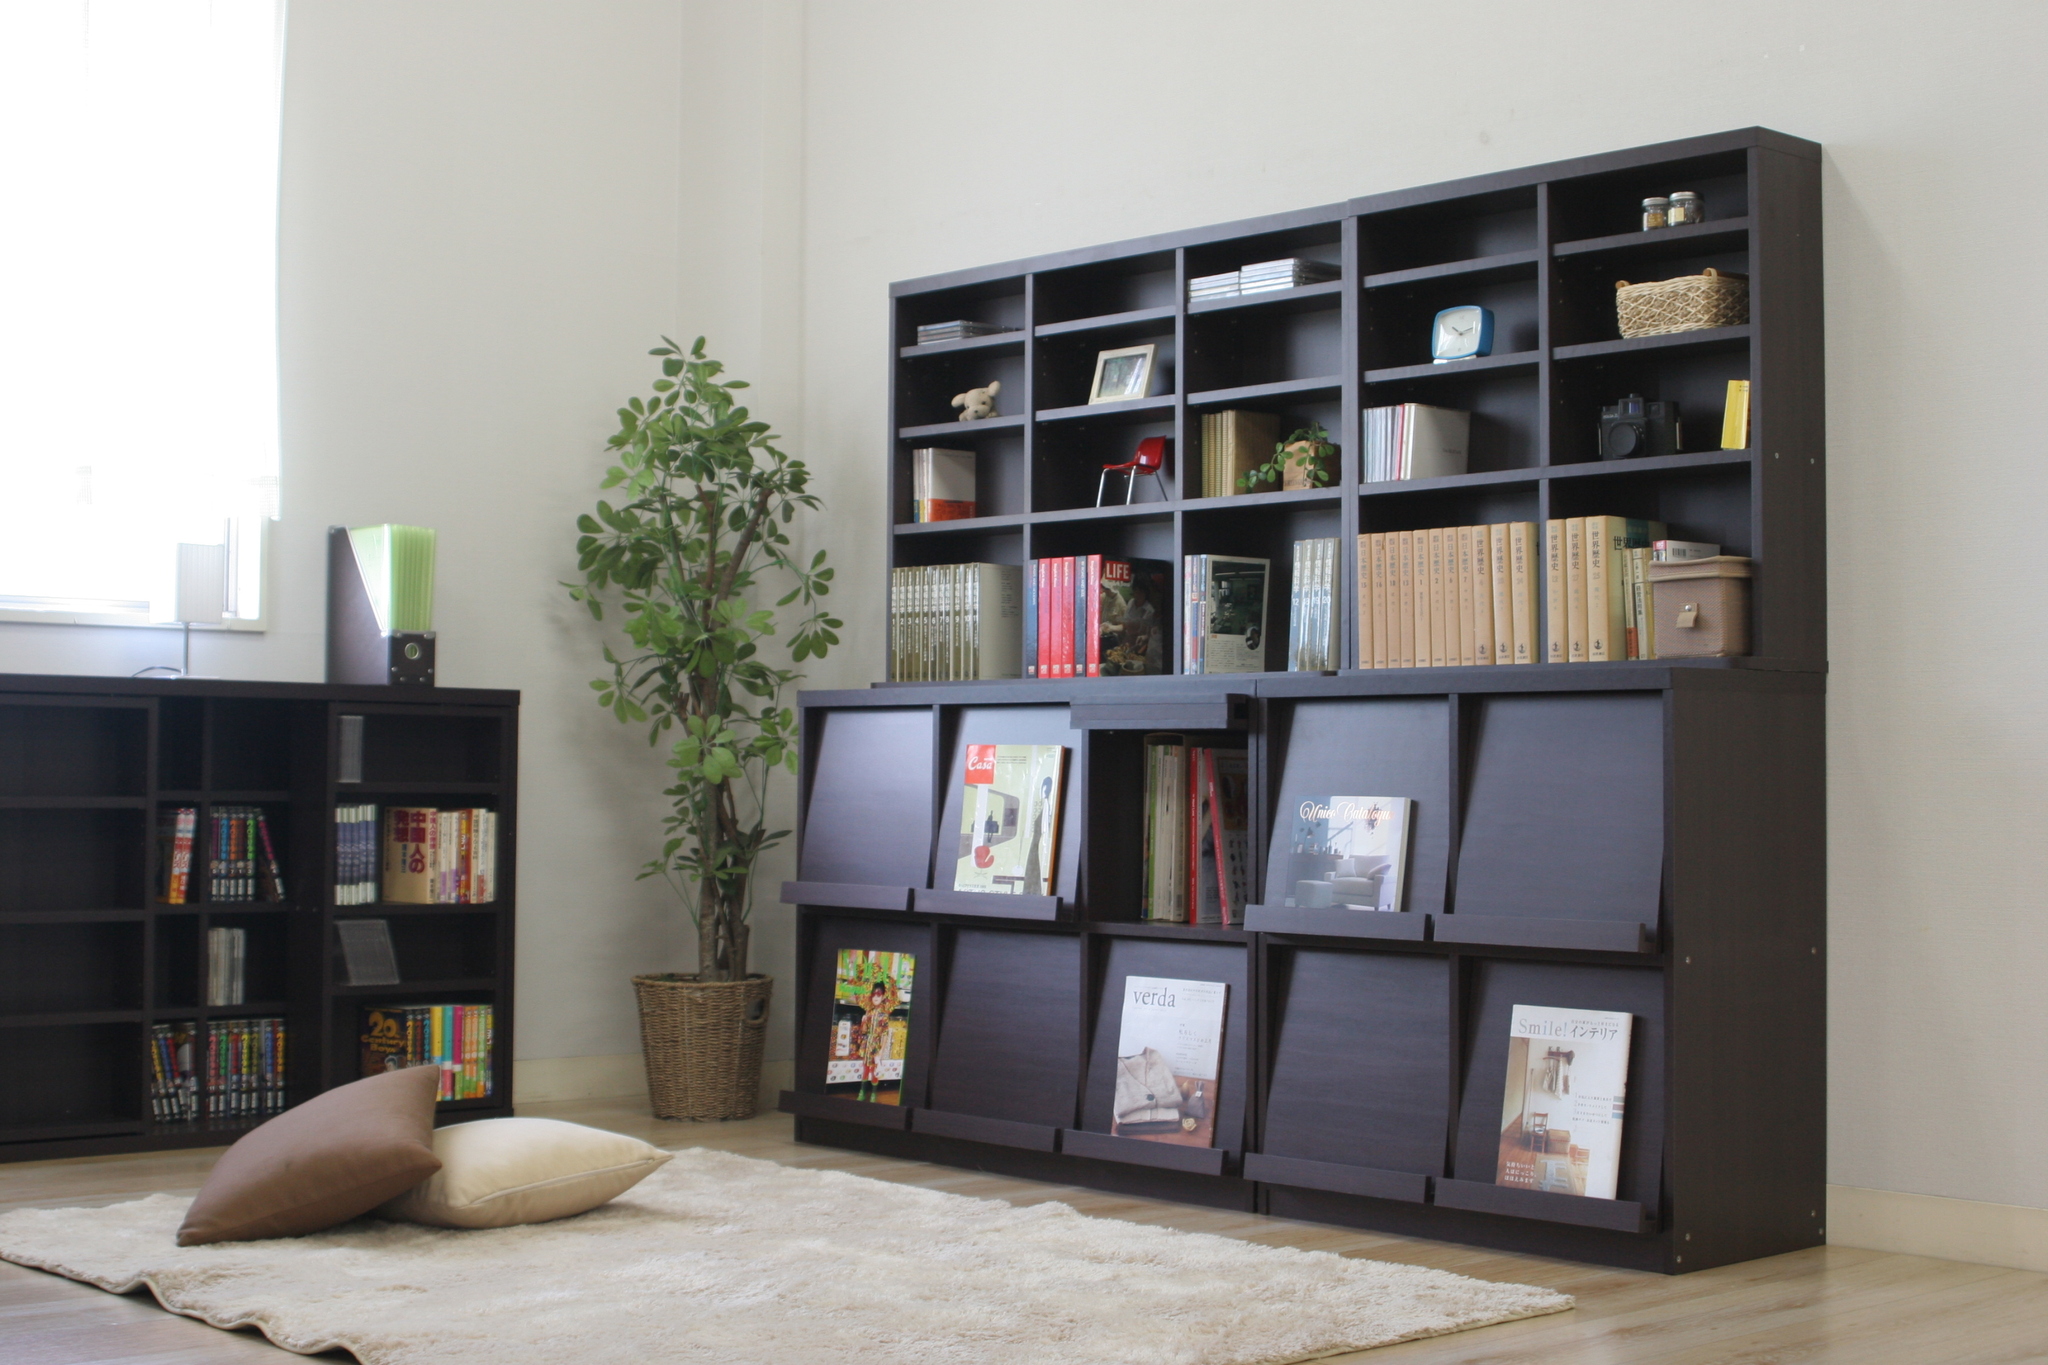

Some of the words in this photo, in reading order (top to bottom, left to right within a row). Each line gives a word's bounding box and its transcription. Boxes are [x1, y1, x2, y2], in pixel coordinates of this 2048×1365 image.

[1550, 534, 1559, 571] 世界歴史
[1571, 533, 1580, 570] 世界歴史
[1592, 531, 1600, 568] 世界歴史
[1106, 563, 1129, 579] LIFE
[968, 756, 992, 770] Casa
[409, 811, 426, 873] 中国人の
[1133, 988, 1176, 1008] verda
[360, 1034, 405, 1047] Century
[1519, 1018, 1567, 1037] Smile!
[1570, 1025, 1618, 1041] インテリア
